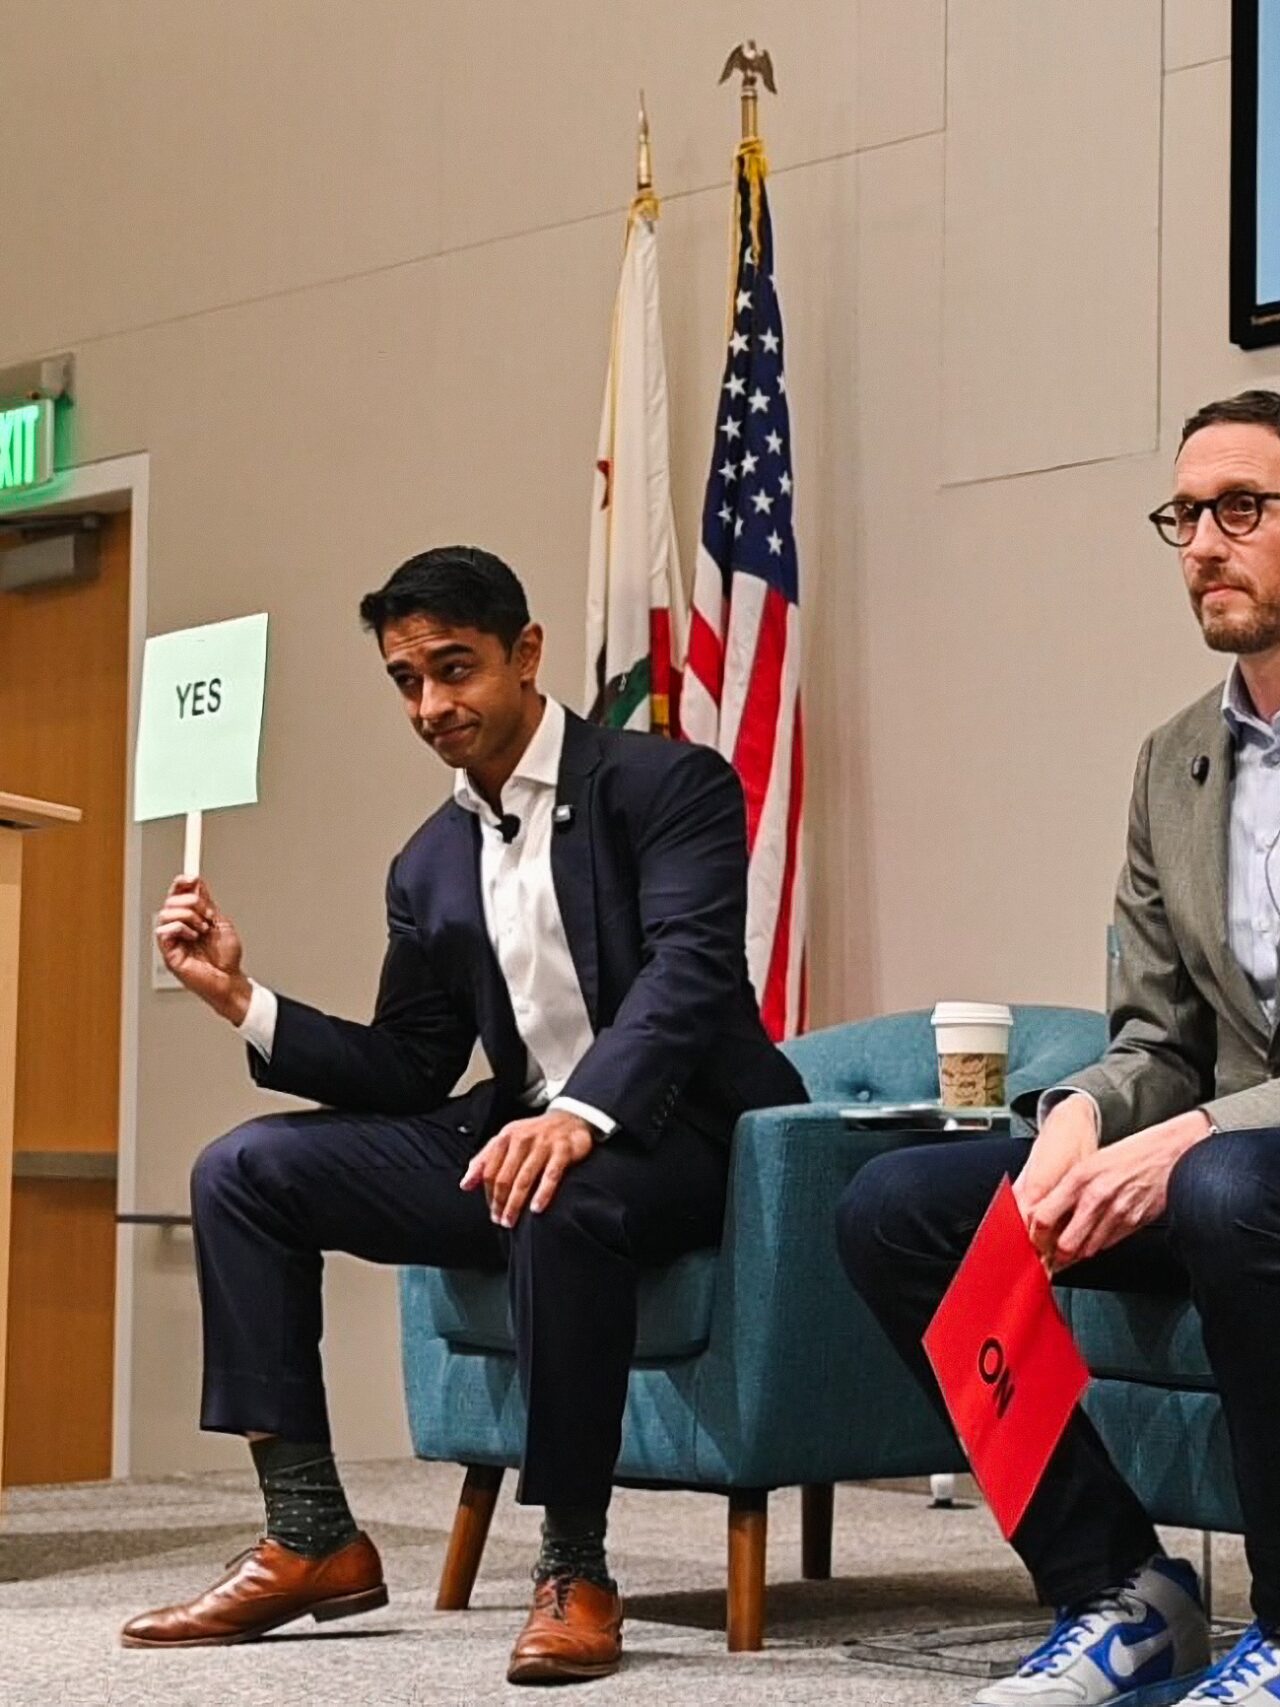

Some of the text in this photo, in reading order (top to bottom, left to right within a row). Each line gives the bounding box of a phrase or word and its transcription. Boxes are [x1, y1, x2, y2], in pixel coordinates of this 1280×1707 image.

[0, 405, 38, 489] XIT
[176, 678, 222, 719] YES
[978, 1337, 1015, 1419] NO
